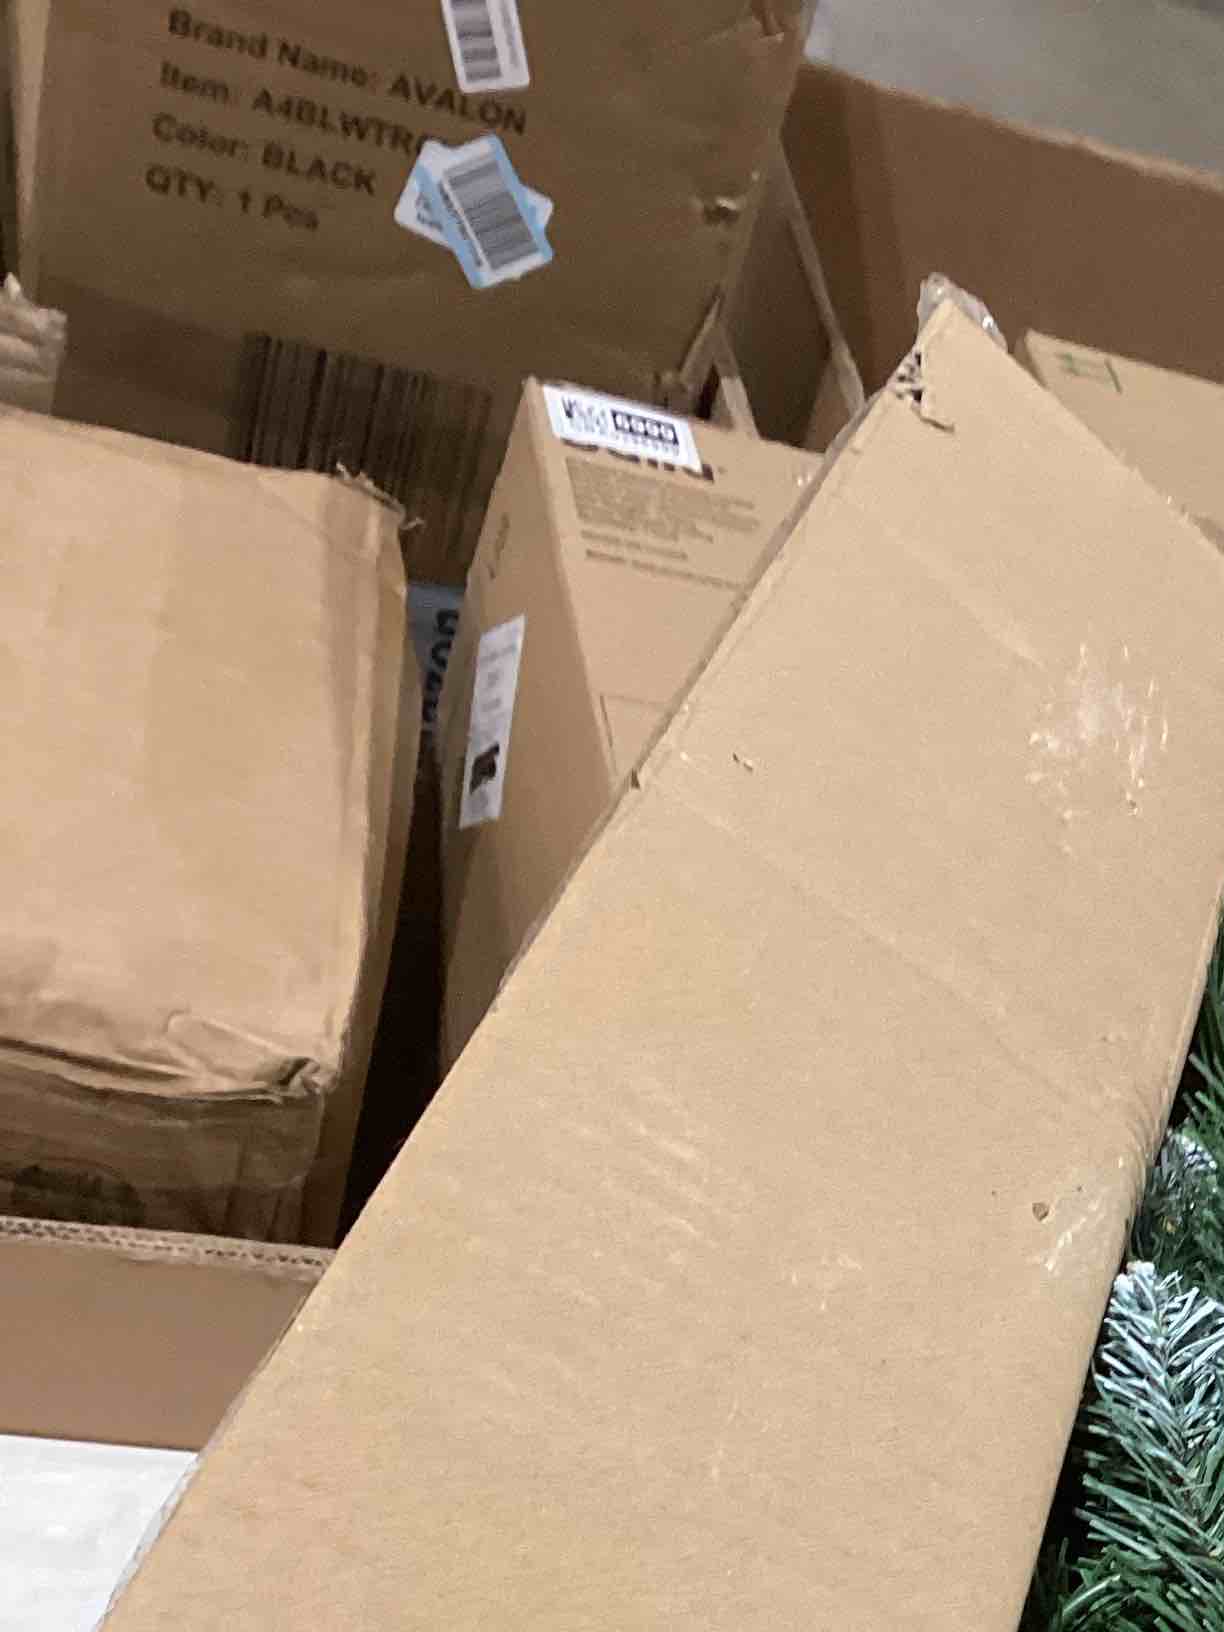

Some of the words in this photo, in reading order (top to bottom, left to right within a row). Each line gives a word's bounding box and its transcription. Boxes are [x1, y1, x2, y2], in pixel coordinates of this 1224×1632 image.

[168, 8, 268, 60] Brand
[387, 73, 527, 136] AVALON
[253, 88, 424, 157] A4BLWTR
[262, 144, 376, 196] BLACK
